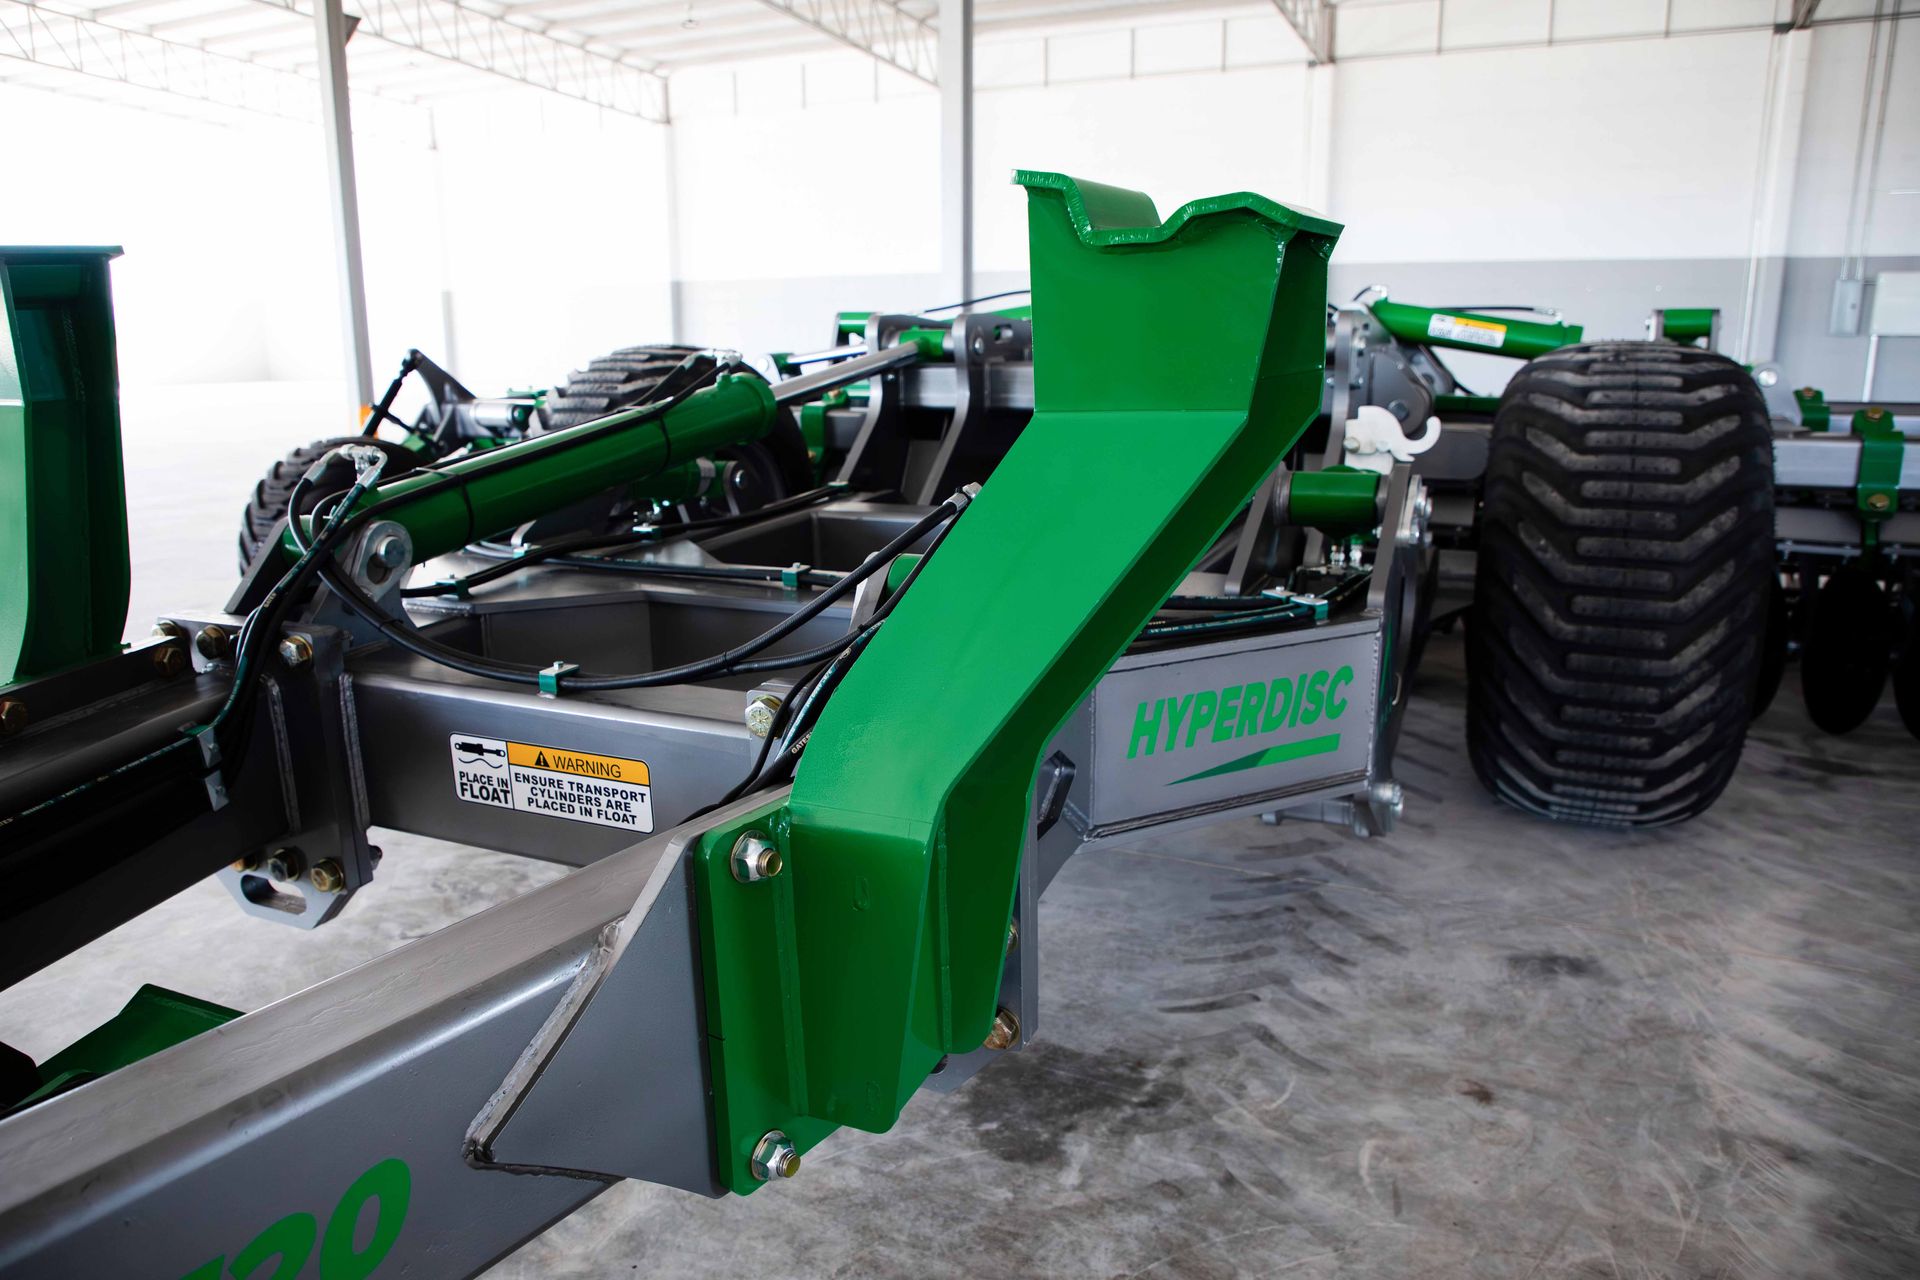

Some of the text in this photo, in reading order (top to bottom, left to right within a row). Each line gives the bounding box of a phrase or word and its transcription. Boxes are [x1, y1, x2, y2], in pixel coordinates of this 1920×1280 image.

[1127, 665, 1354, 760] HYPERDISC
[459, 771, 509, 789] PLACE IN
[552, 755, 622, 778] WARNING
[460, 782, 511, 805] FLOAT
[514, 772, 647, 803] ENSURE TRANSPORT
[530, 786, 632, 813] CYLINDERS ARE
[527, 797, 637, 825] PLACED IN FLOAT
[177, 1157, 412, 1280] 20
